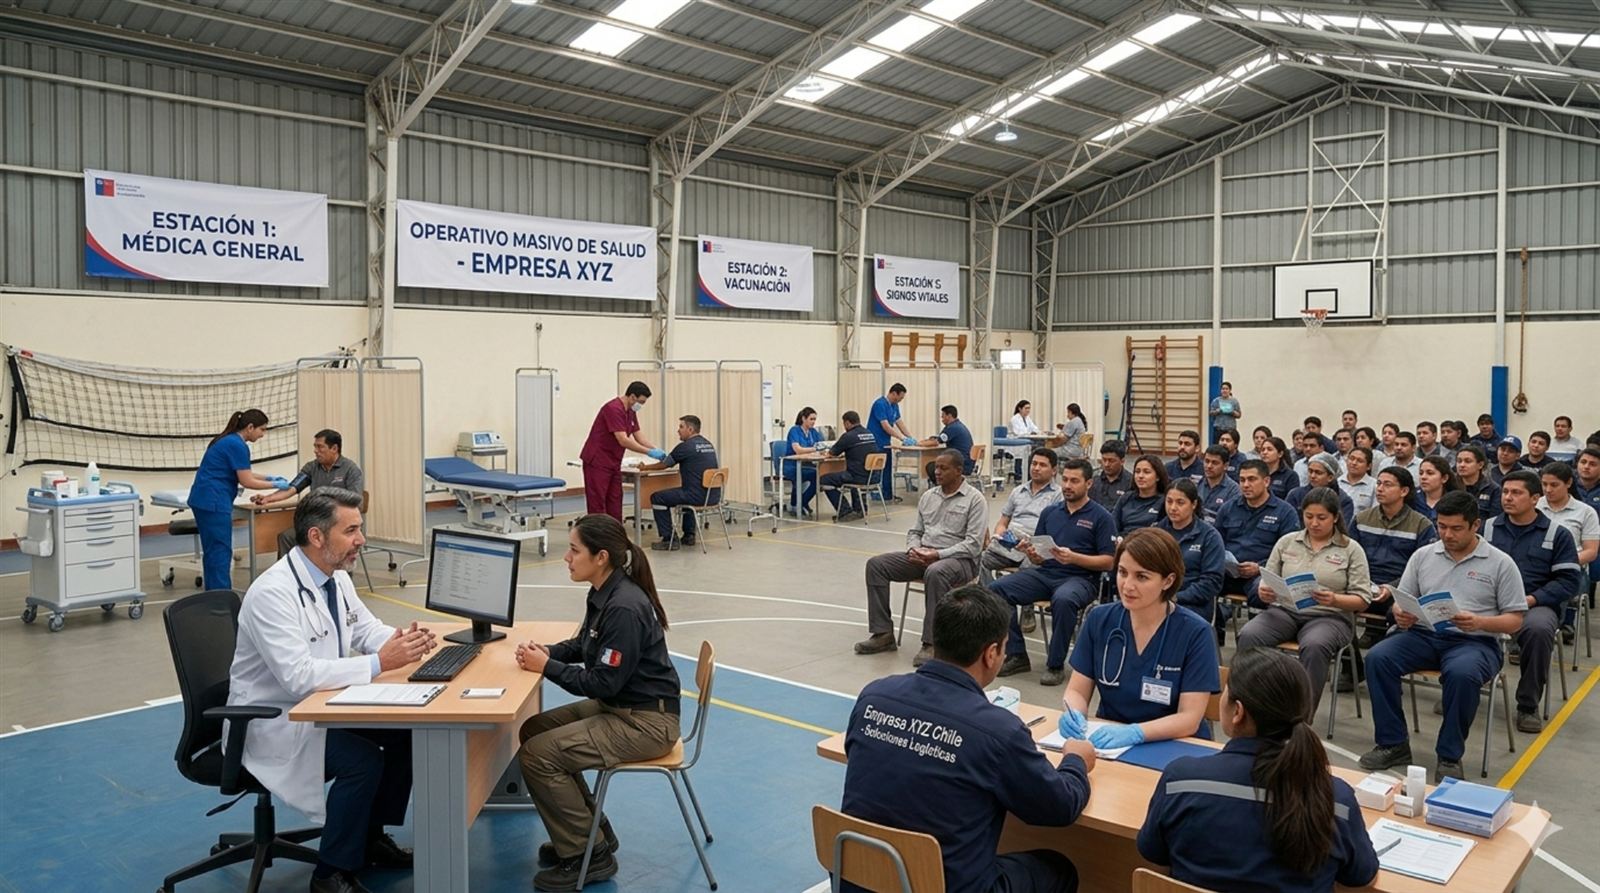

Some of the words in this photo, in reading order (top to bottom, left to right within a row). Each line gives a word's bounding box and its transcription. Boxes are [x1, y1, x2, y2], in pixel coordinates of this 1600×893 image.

[152, 211, 254, 236] ESTACIÓN
[262, 221, 277, 237] 1:
[122, 231, 207, 256] MÉDICA
[212, 240, 304, 262] GENERAL
[410, 222, 508, 246] OPERATIVO
[513, 232, 574, 253] MASIVO
[578, 238, 596, 254] DE
[600, 240, 646, 258] SALUD
[472, 252, 572, 280] EMPRESA
[576, 260, 614, 282] XYZ
[728, 262, 777, 278] ESTACIÓN
[779, 266, 788, 278] 2:
[724, 276, 790, 293] VACUNACIÓN
[886, 289, 917, 302] SIGNOS
[908, 718, 932, 738] XYZ
[932, 726, 963, 747] Chile
